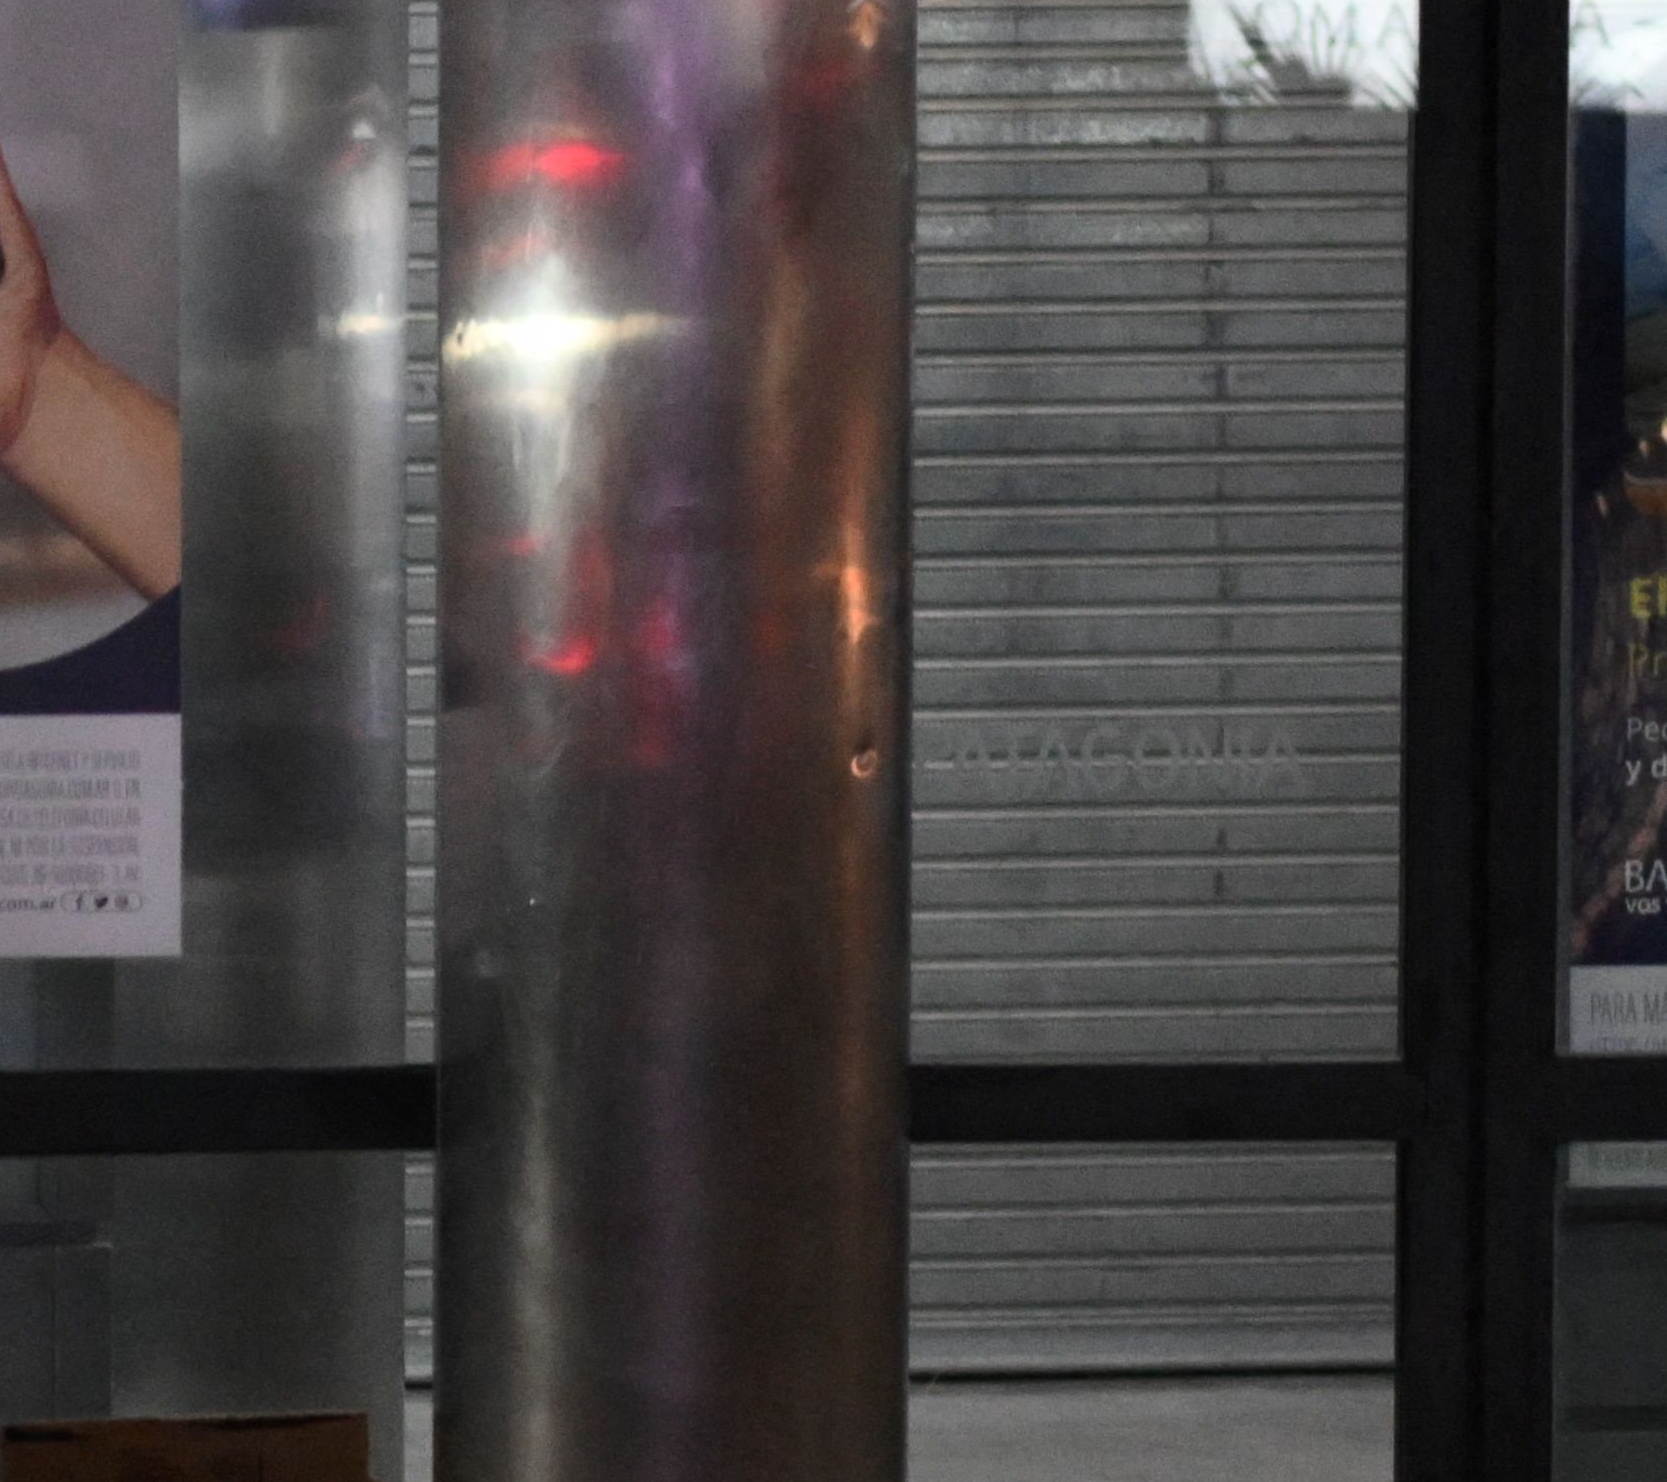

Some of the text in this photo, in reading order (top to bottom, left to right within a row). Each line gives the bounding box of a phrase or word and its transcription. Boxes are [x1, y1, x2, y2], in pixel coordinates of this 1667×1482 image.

[1624, 758, 1641, 787] y
[1625, 895, 1661, 916] VOS
[1589, 991, 1637, 1025] PARA
